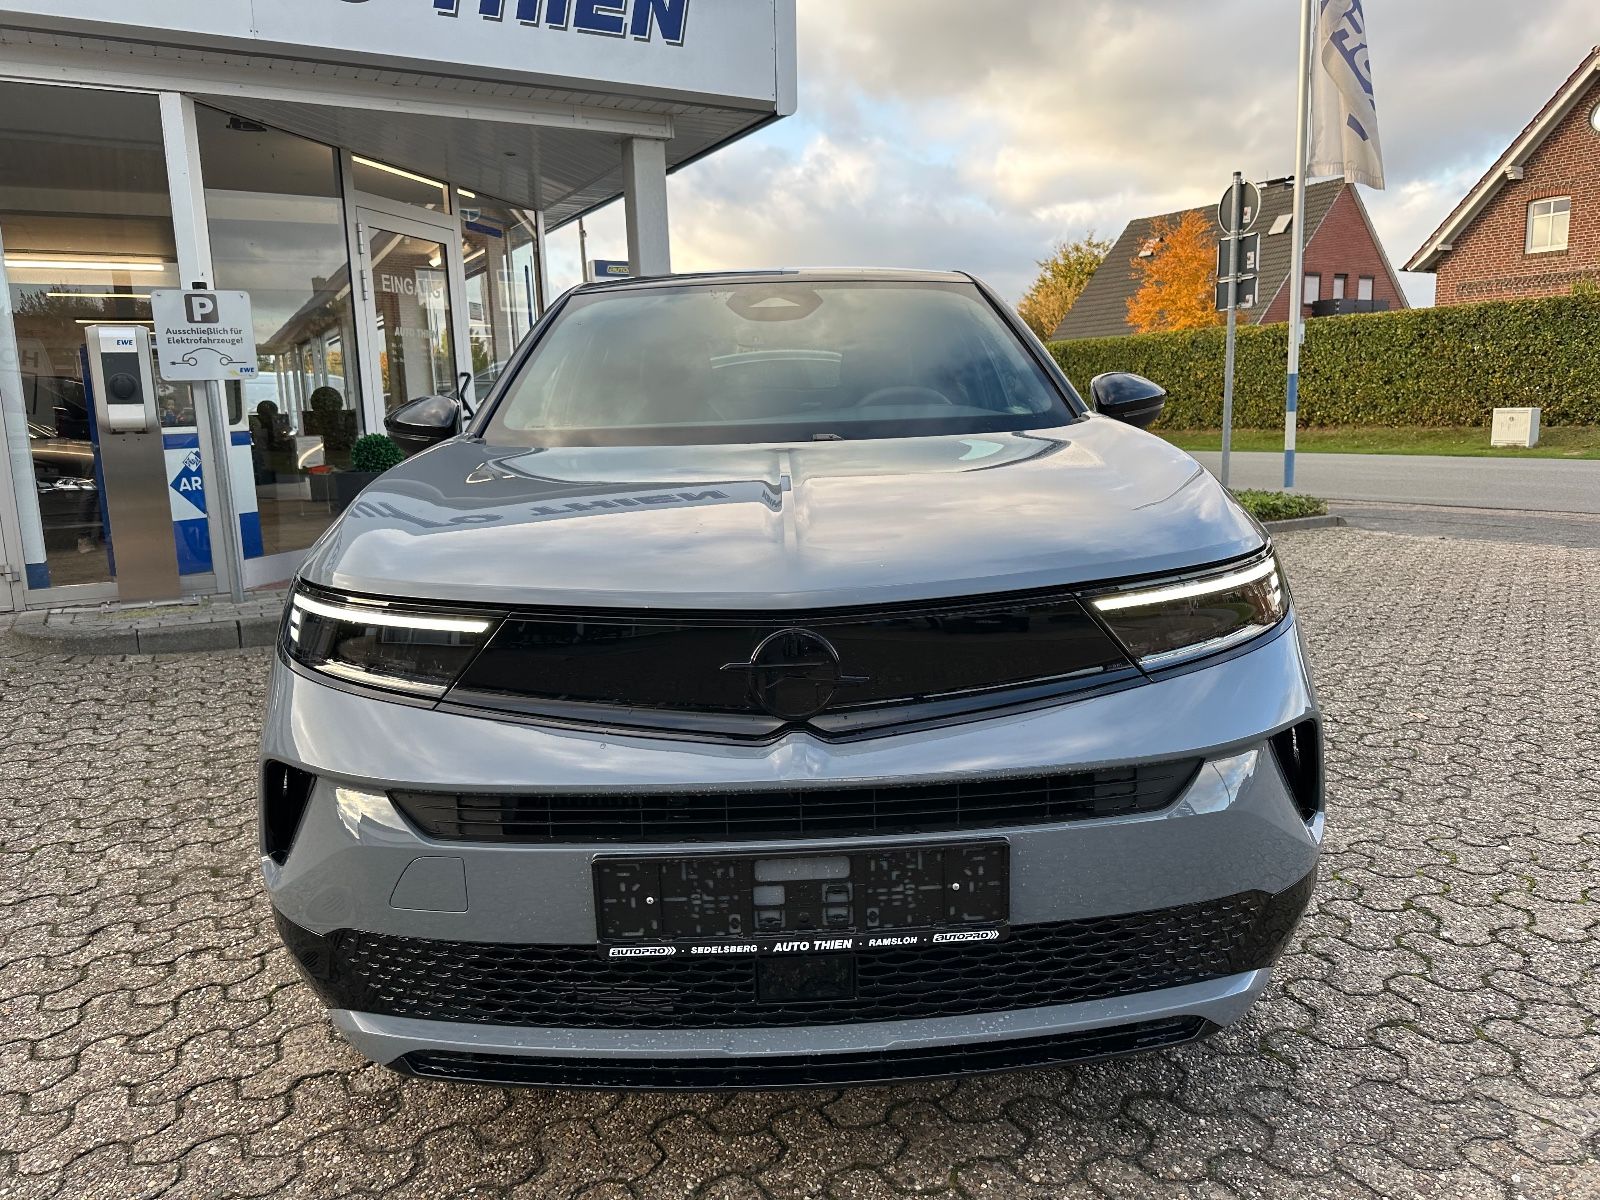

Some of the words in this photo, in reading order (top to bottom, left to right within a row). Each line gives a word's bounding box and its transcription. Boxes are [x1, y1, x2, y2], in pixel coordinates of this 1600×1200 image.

[381, 274, 442, 299] EINGANG
[165, 327, 229, 336] Ausschließlich
[230, 327, 243, 335] für
[167, 336, 244, 346] Elektrofahrzeuge!
[691, 945, 758, 954] SEDELSBERG
[773, 941, 810, 953] AUTO
[813, 939, 853, 951] THIEN
[868, 936, 918, 947] RAMSLOH
